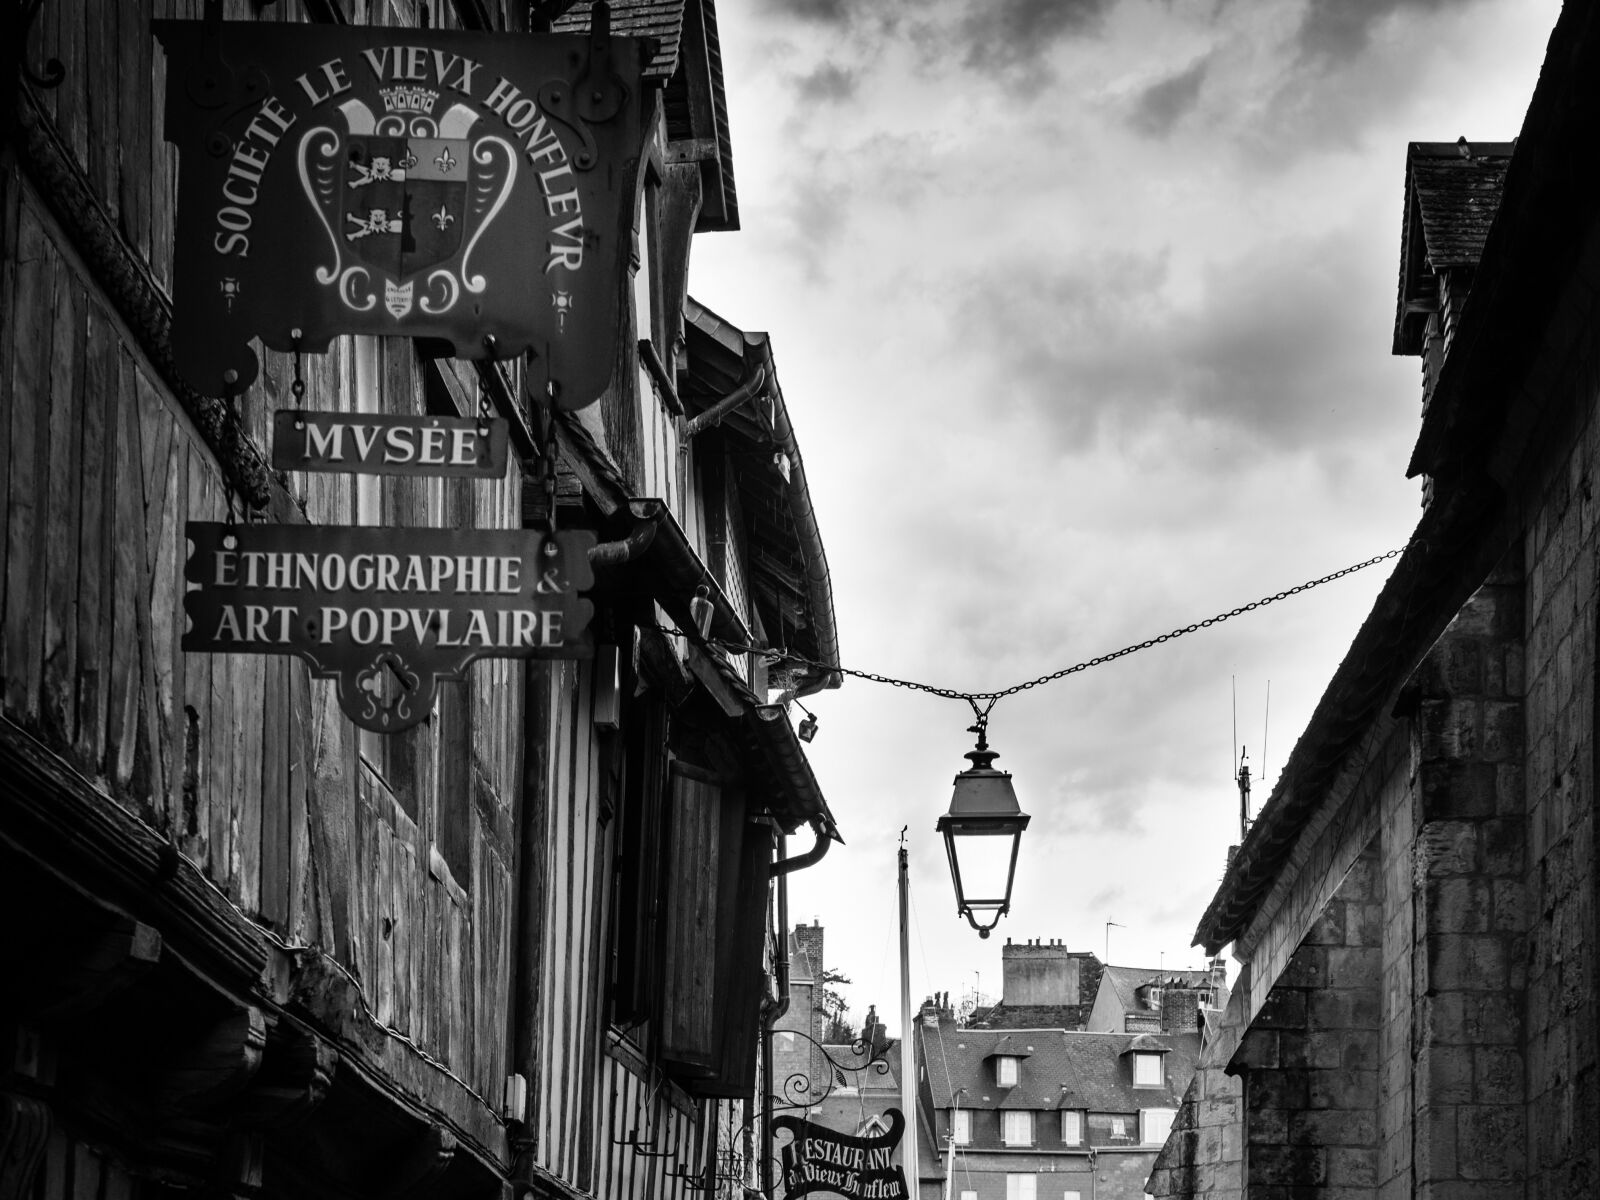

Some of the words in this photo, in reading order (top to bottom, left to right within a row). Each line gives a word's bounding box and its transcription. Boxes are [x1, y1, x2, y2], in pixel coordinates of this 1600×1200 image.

[214, 96, 297, 257] SOCIÉTÉ
[296, 58, 352, 107] LE
[360, 46, 483, 95] VIEVX
[481, 76, 584, 275] HONFLEVR
[303, 419, 478, 465] MVSÉE
[537, 567, 570, 594] &
[213, 604, 297, 643] ART
[320, 605, 564, 648] POPVLAIRE
[803, 1163, 845, 1186] Vieux
